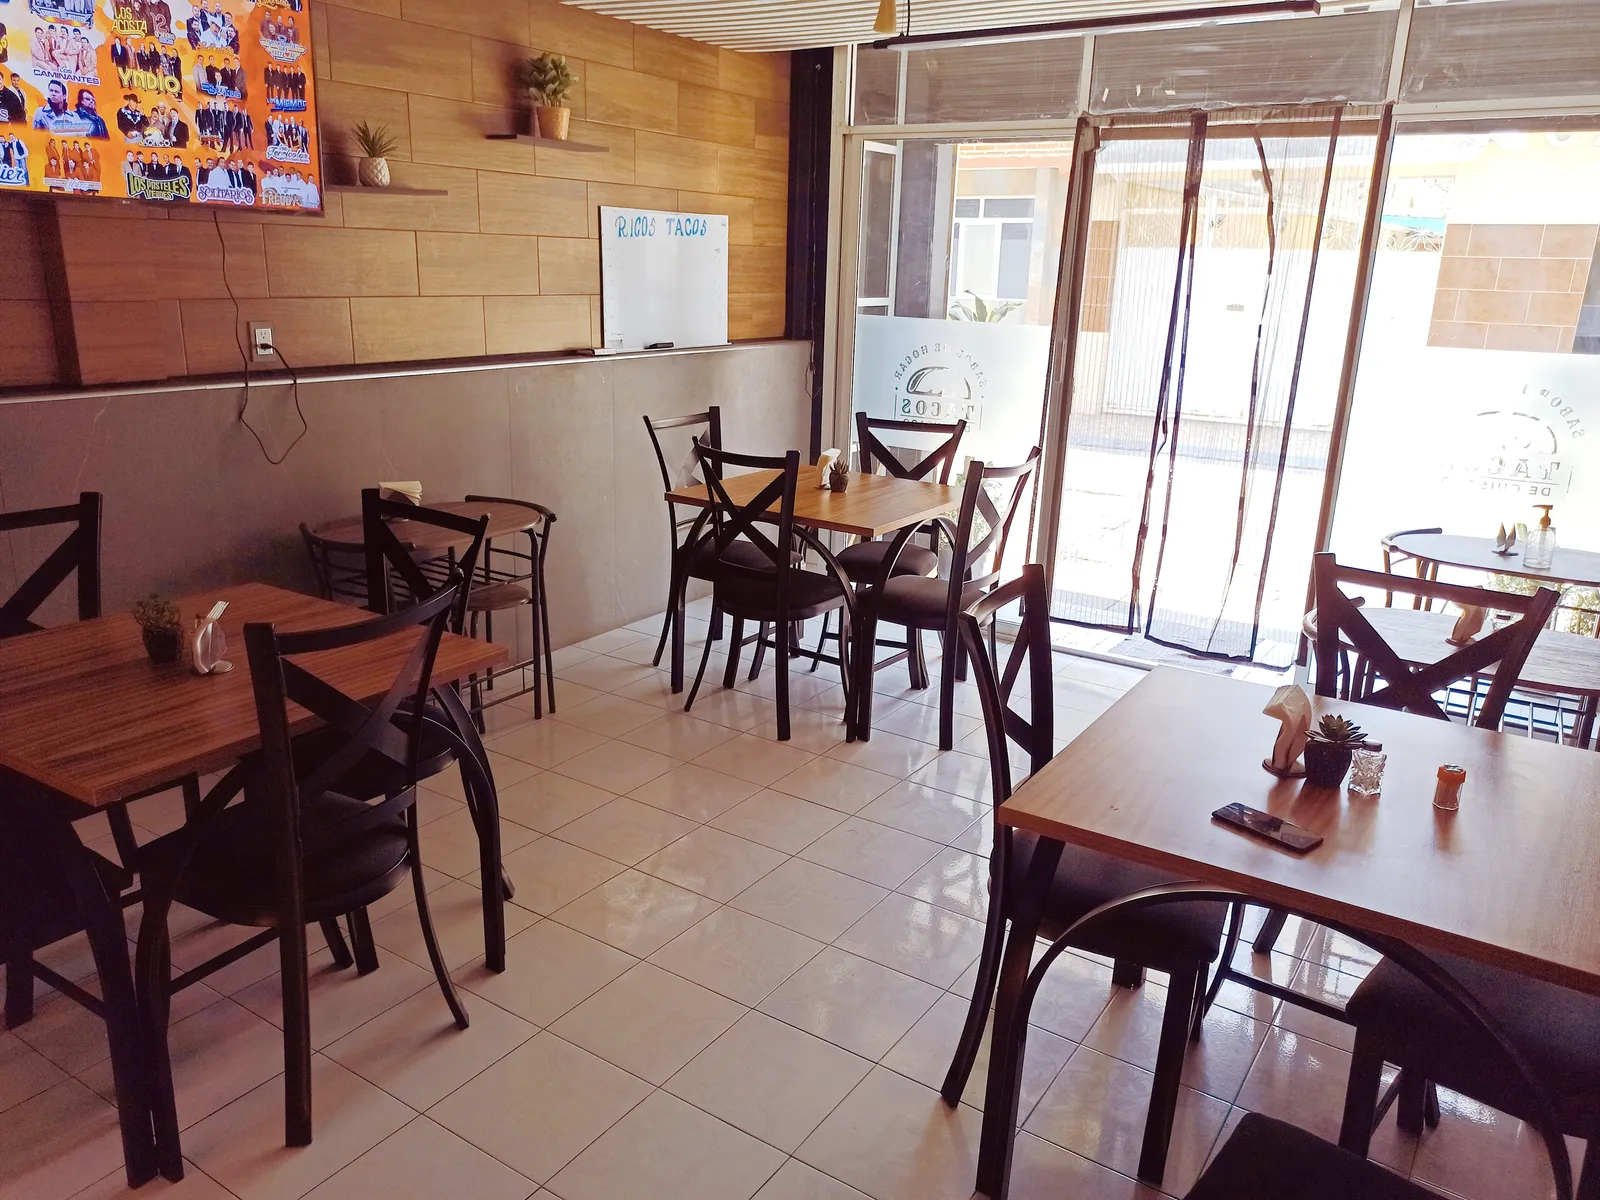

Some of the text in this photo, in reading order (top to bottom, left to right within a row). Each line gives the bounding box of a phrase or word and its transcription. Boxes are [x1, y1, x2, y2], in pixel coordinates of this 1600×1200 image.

[114, 6, 132, 20] LOS
[111, 18, 148, 35] ACOSTA
[33, 69, 100, 85] CAMINANTES
[117, 66, 180, 95] YNDIO
[128, 174, 189, 198] LOS PASTELES
[199, 186, 254, 205] SOLITARIOS
[615, 215, 707, 238] RICOS TACOS
